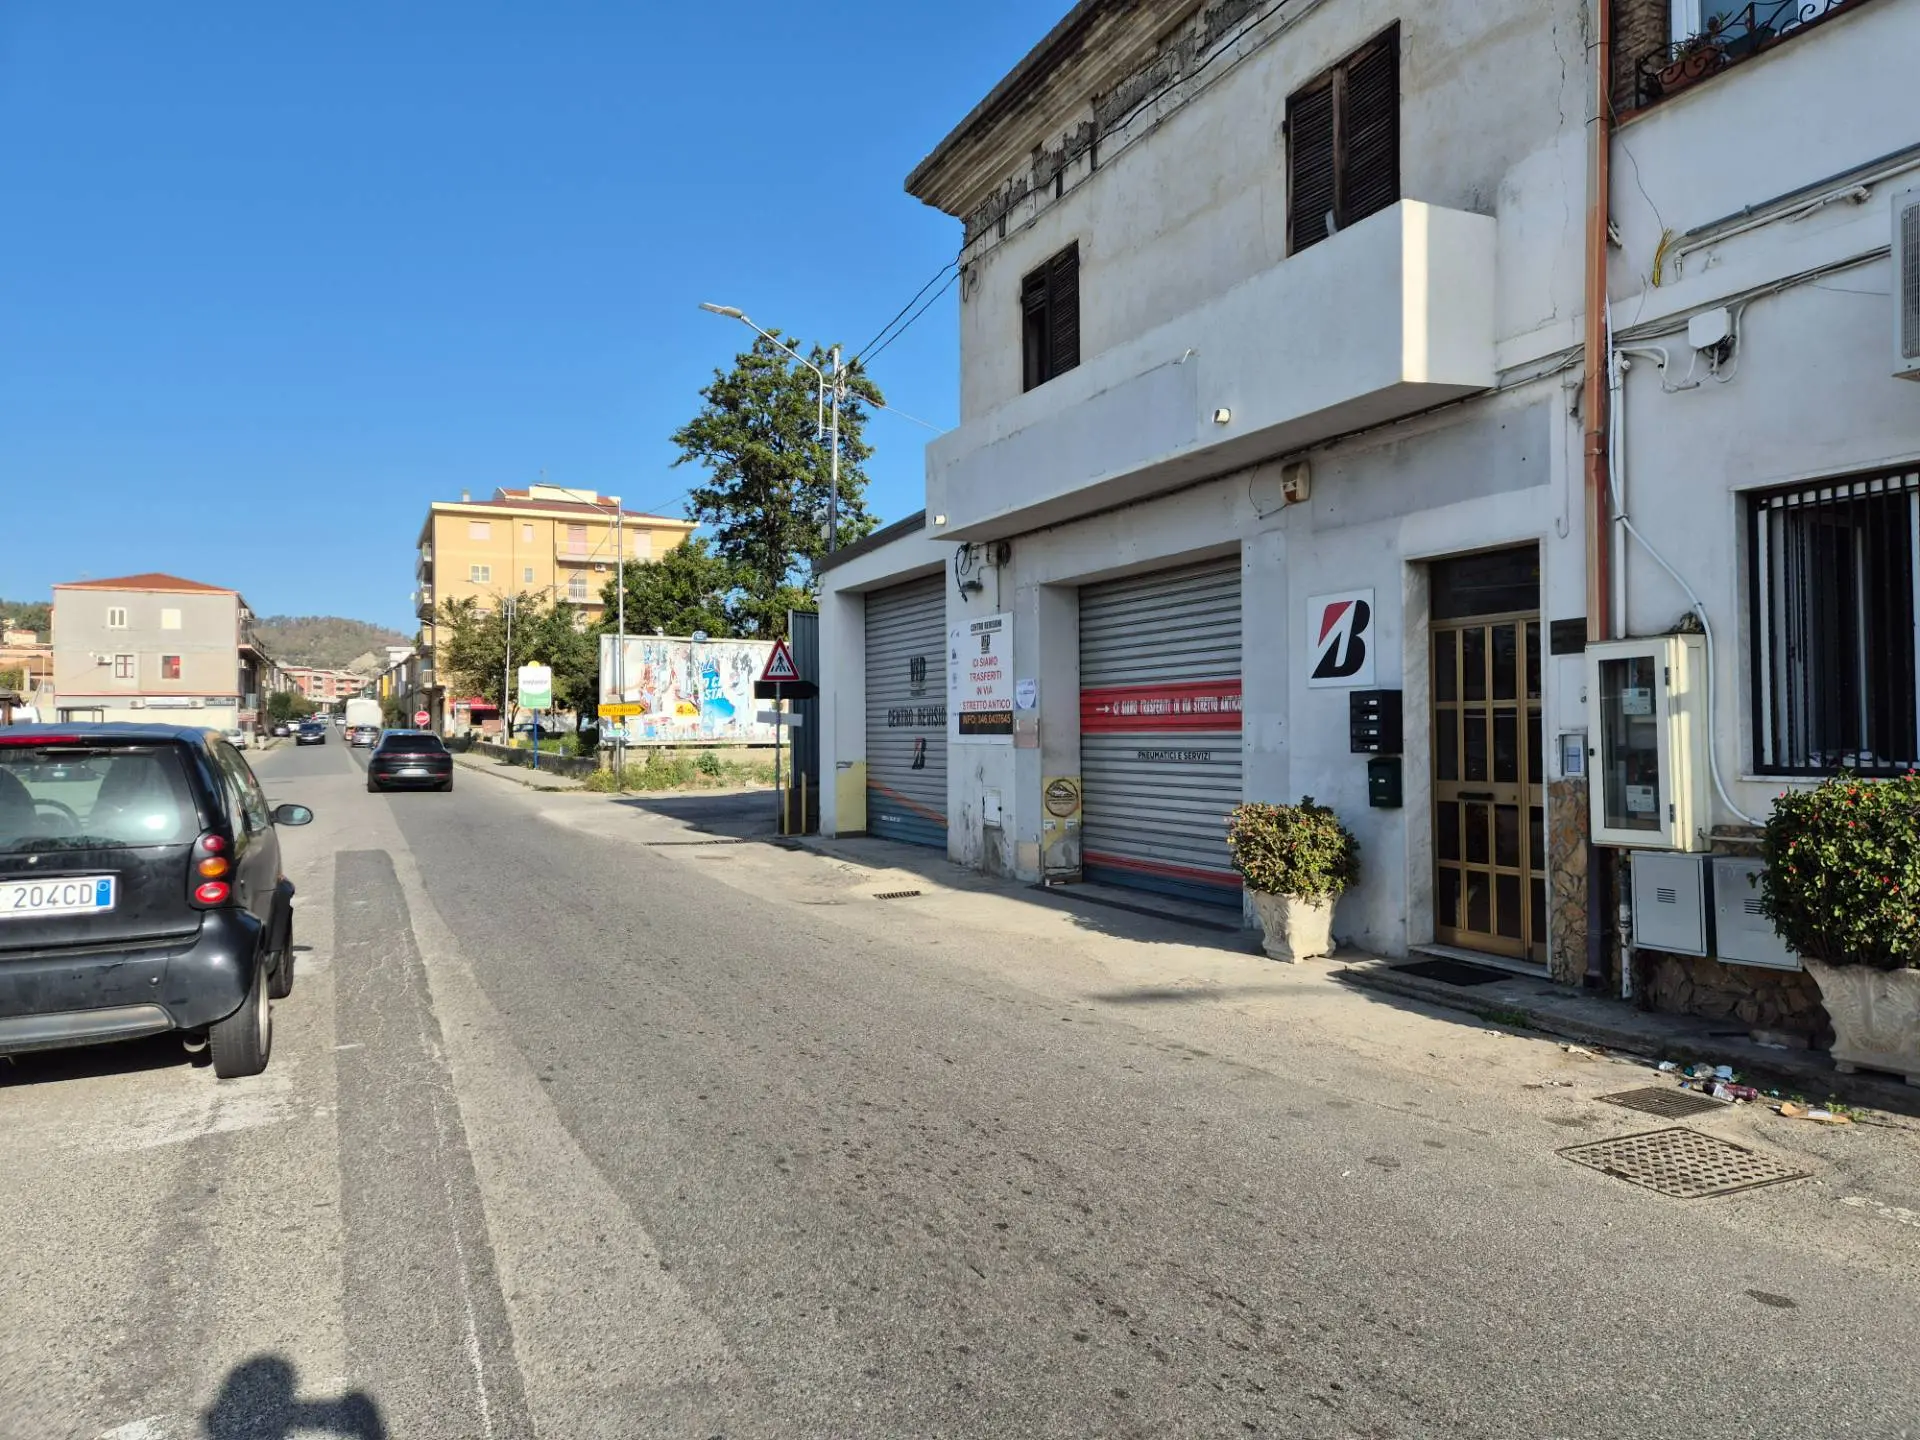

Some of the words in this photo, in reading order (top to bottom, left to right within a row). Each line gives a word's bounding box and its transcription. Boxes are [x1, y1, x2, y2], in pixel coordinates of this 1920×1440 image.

[973, 658, 978, 668] CI
[980, 656, 998, 667] SIAMO
[970, 670, 1002, 682] TRASFERITI
[976, 686, 982, 695] IN
[984, 684, 992, 695] VIA
[962, 700, 987, 710] STRETTO
[988, 698, 1010, 709] ANTICO
[1194, 696, 1218, 712] STRETTO
[888, 708, 913, 728] CENTRO
[1138, 751, 1177, 760] PNEUMATICI
[1184, 752, 1211, 760] SERVIZI
[14, 883, 92, 908] 204CD
